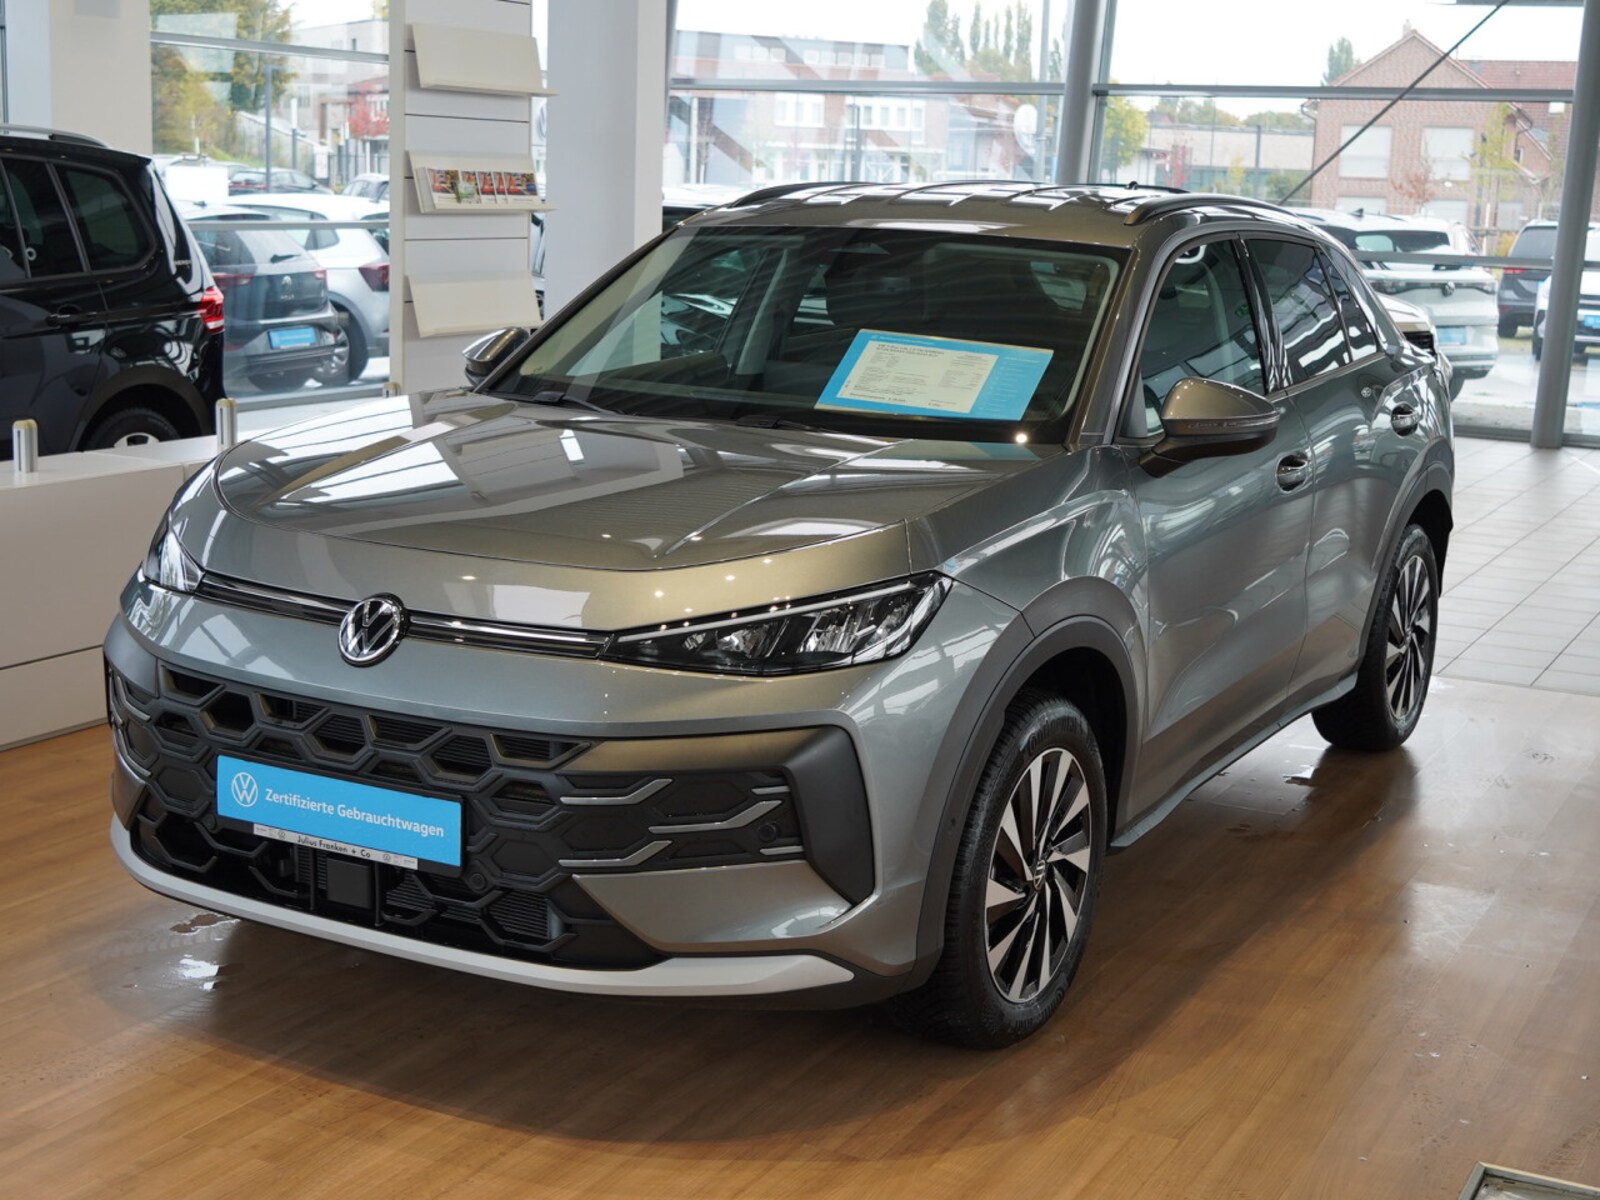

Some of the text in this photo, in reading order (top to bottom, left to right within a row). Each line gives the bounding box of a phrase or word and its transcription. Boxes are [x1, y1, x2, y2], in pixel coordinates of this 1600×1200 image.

[264, 788, 445, 838] Zertifizierte Gebrauchtwagen
[297, 835, 317, 847] Julius
[360, 849, 371, 858] Co
